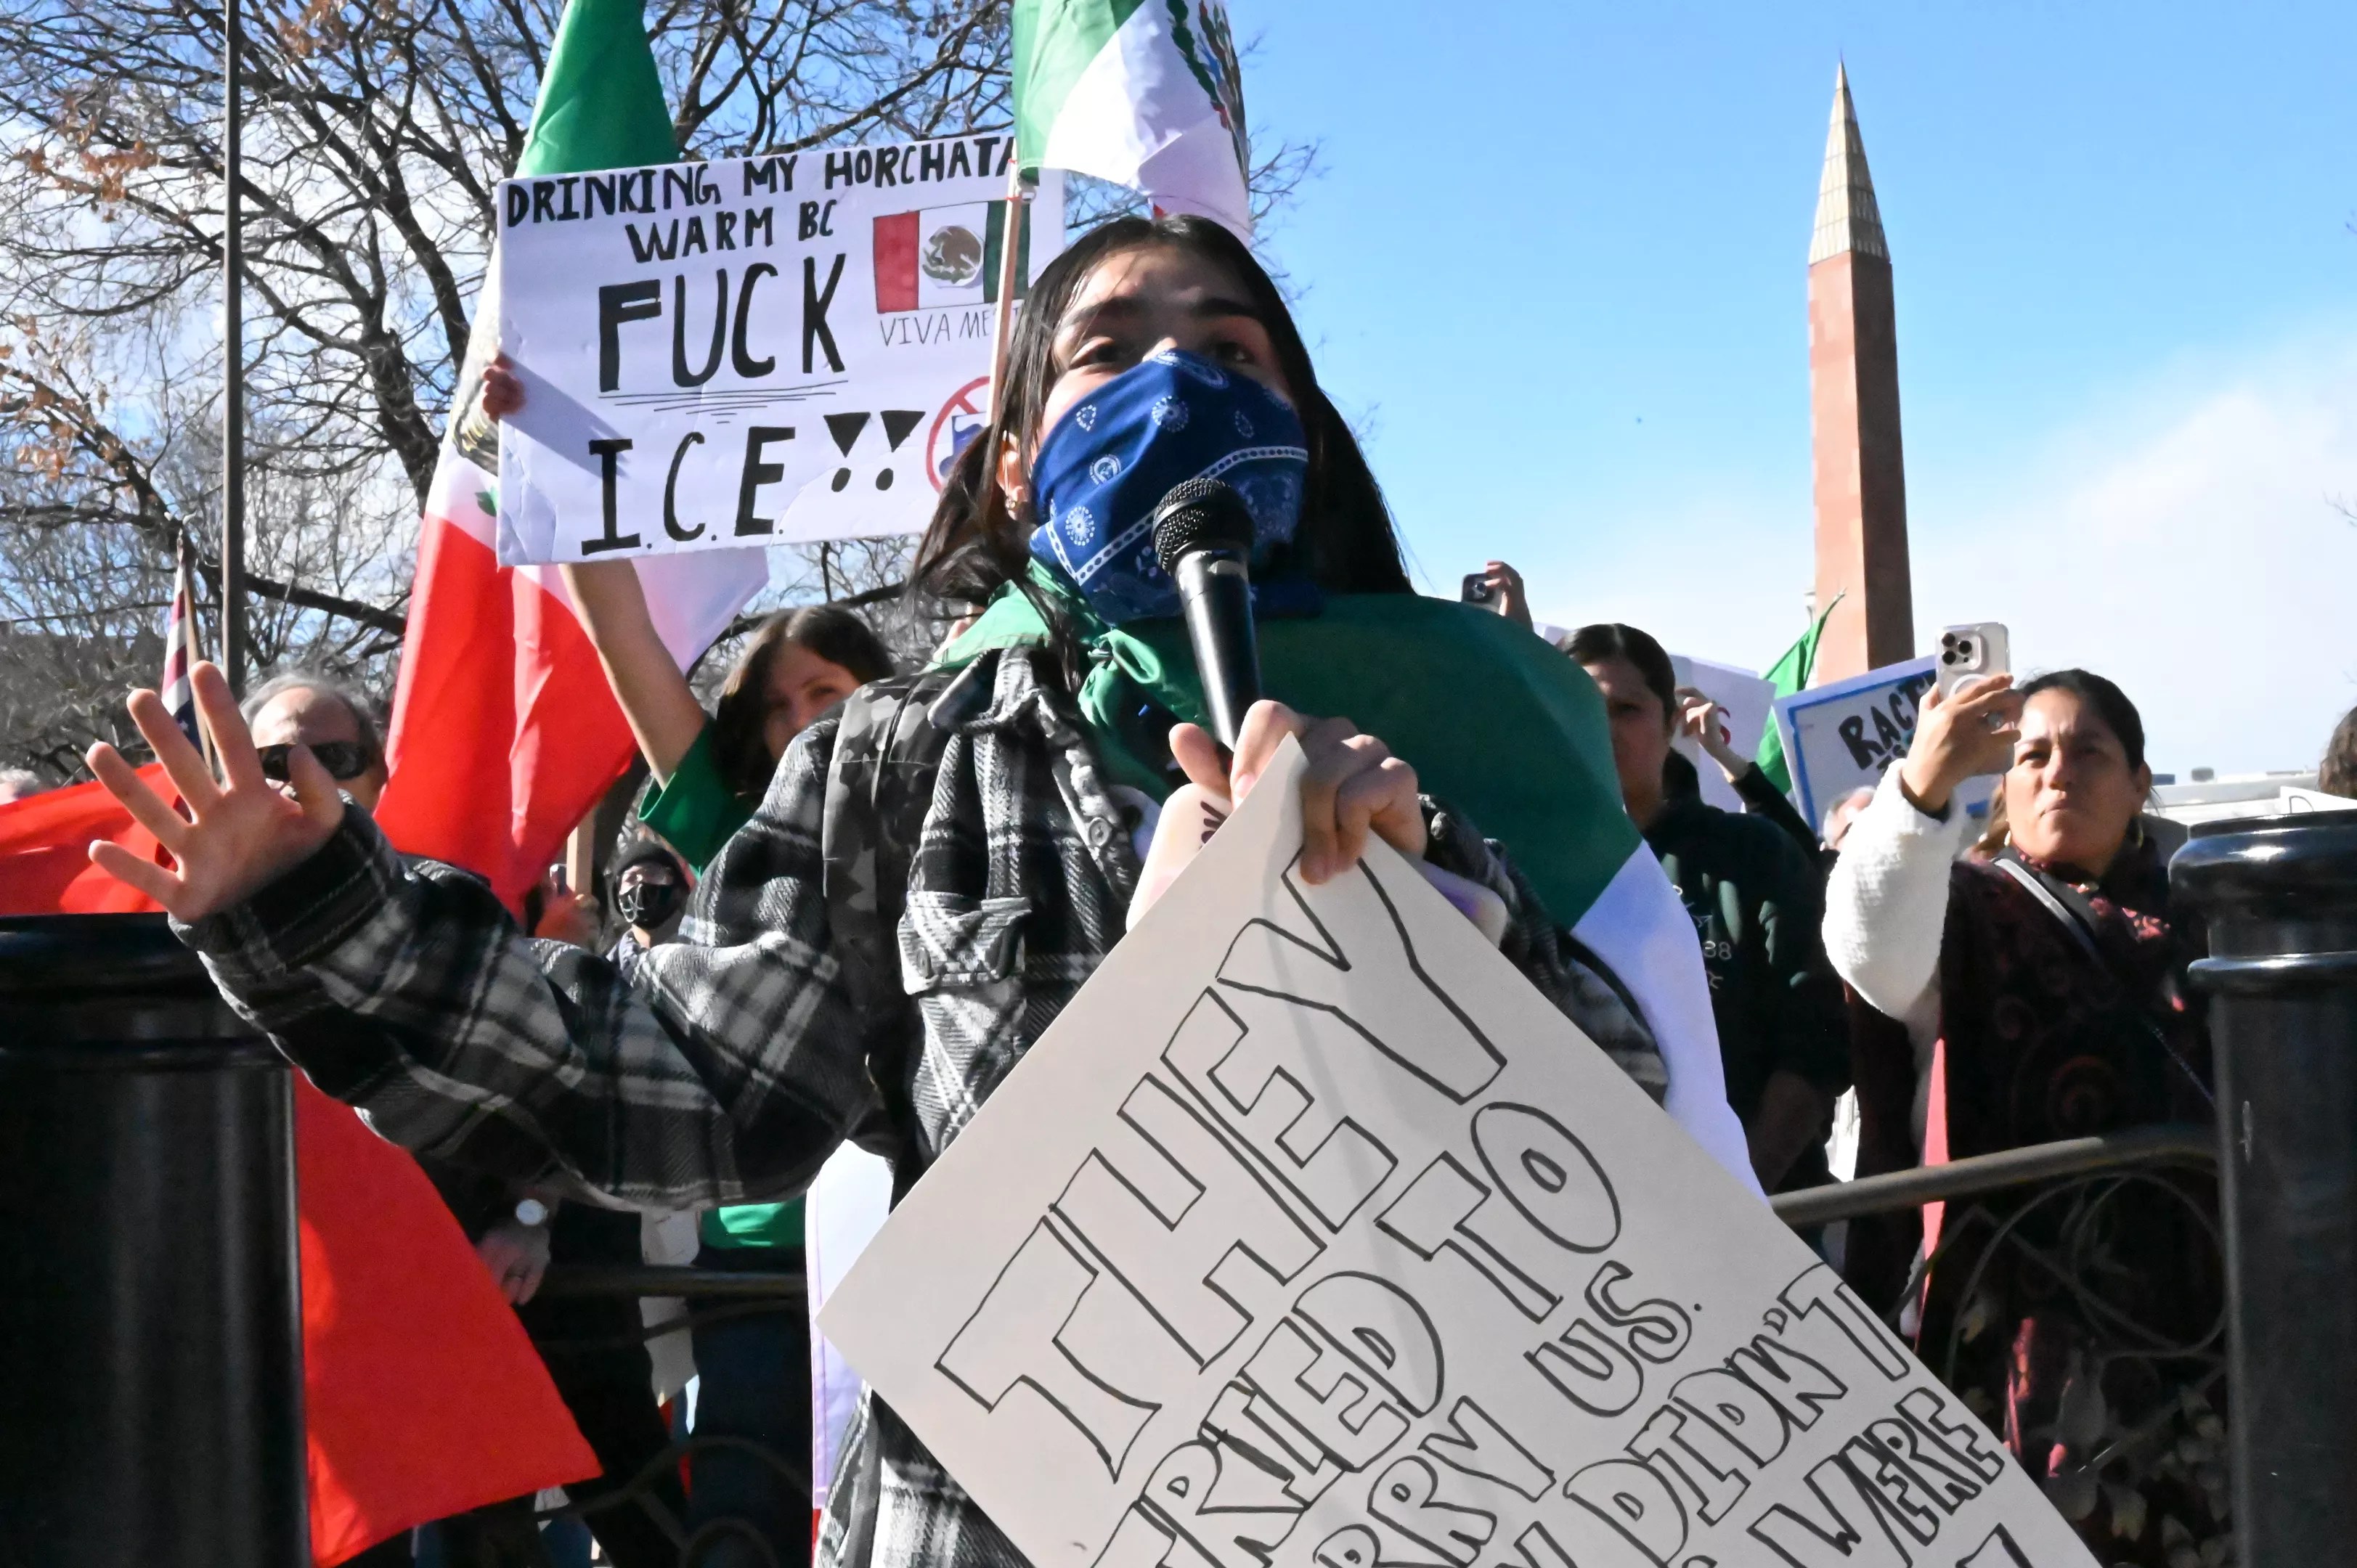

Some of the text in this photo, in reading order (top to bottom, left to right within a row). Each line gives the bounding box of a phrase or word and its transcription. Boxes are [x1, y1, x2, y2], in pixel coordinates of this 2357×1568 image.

[507, 161, 720, 228] DRINKING
[743, 153, 797, 197] MY
[625, 199, 834, 263] WARM BC
[598, 253, 846, 393] FUCK
[879, 308, 996, 347] VIVA ME
[934, 842, 1507, 1484] THEY
[1089, 1101, 1622, 1568] RIED TO
[1745, 1386, 2006, 1568] WERE
